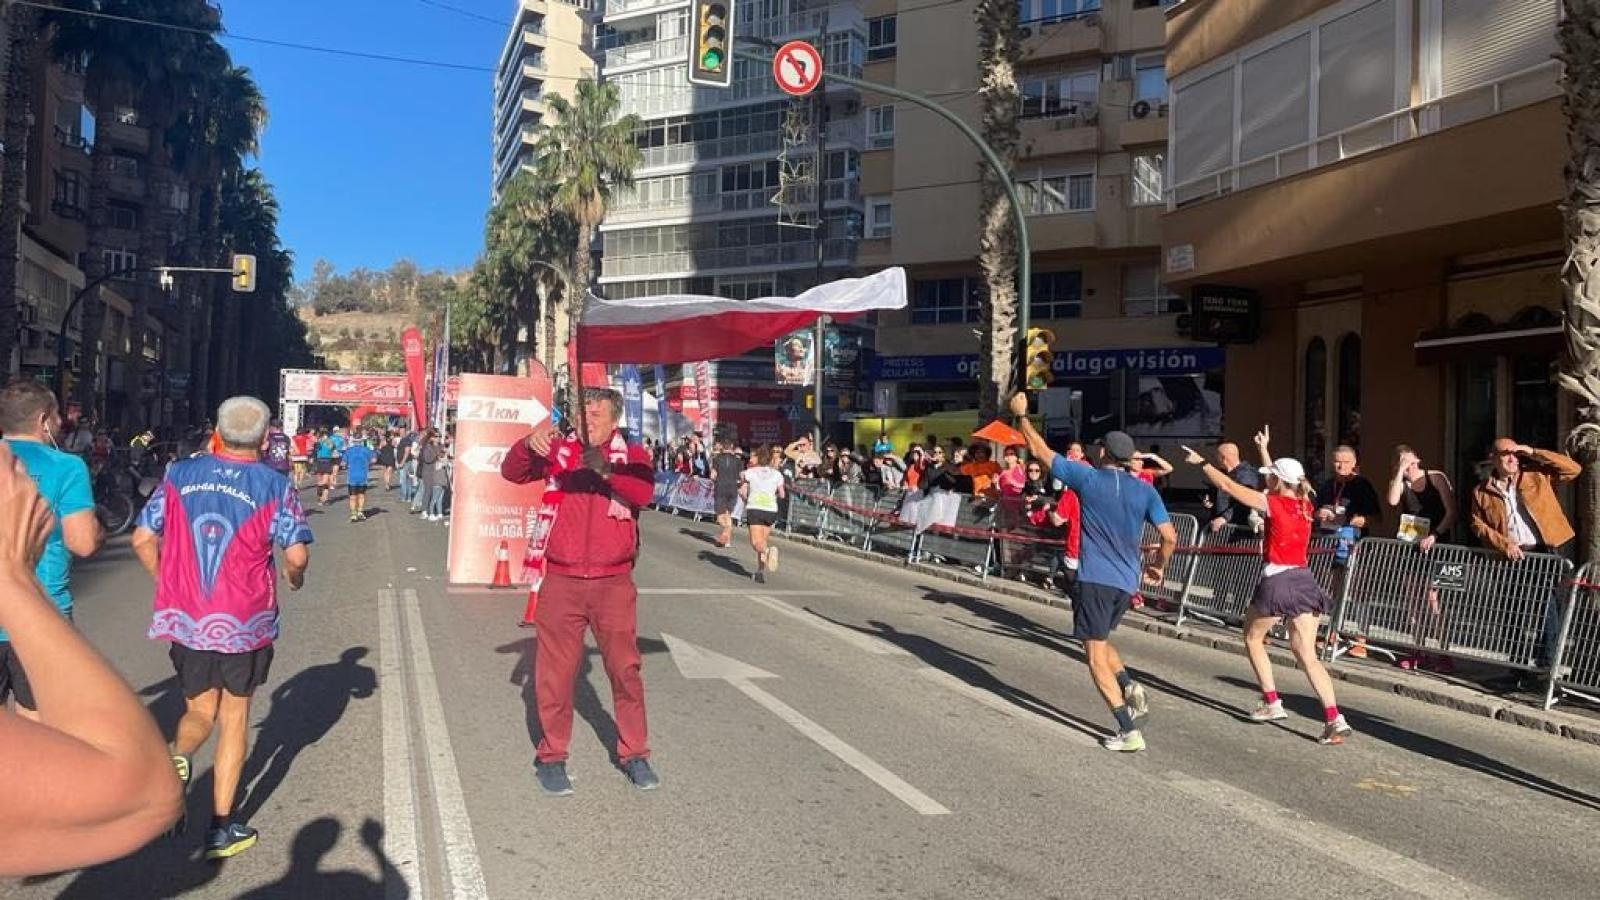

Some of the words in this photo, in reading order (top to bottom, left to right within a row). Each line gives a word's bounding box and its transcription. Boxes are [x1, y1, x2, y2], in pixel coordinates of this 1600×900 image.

[1052, 353, 1117, 374] álaga
[1126, 350, 1196, 369] visión
[1440, 565, 1462, 577] AMS
